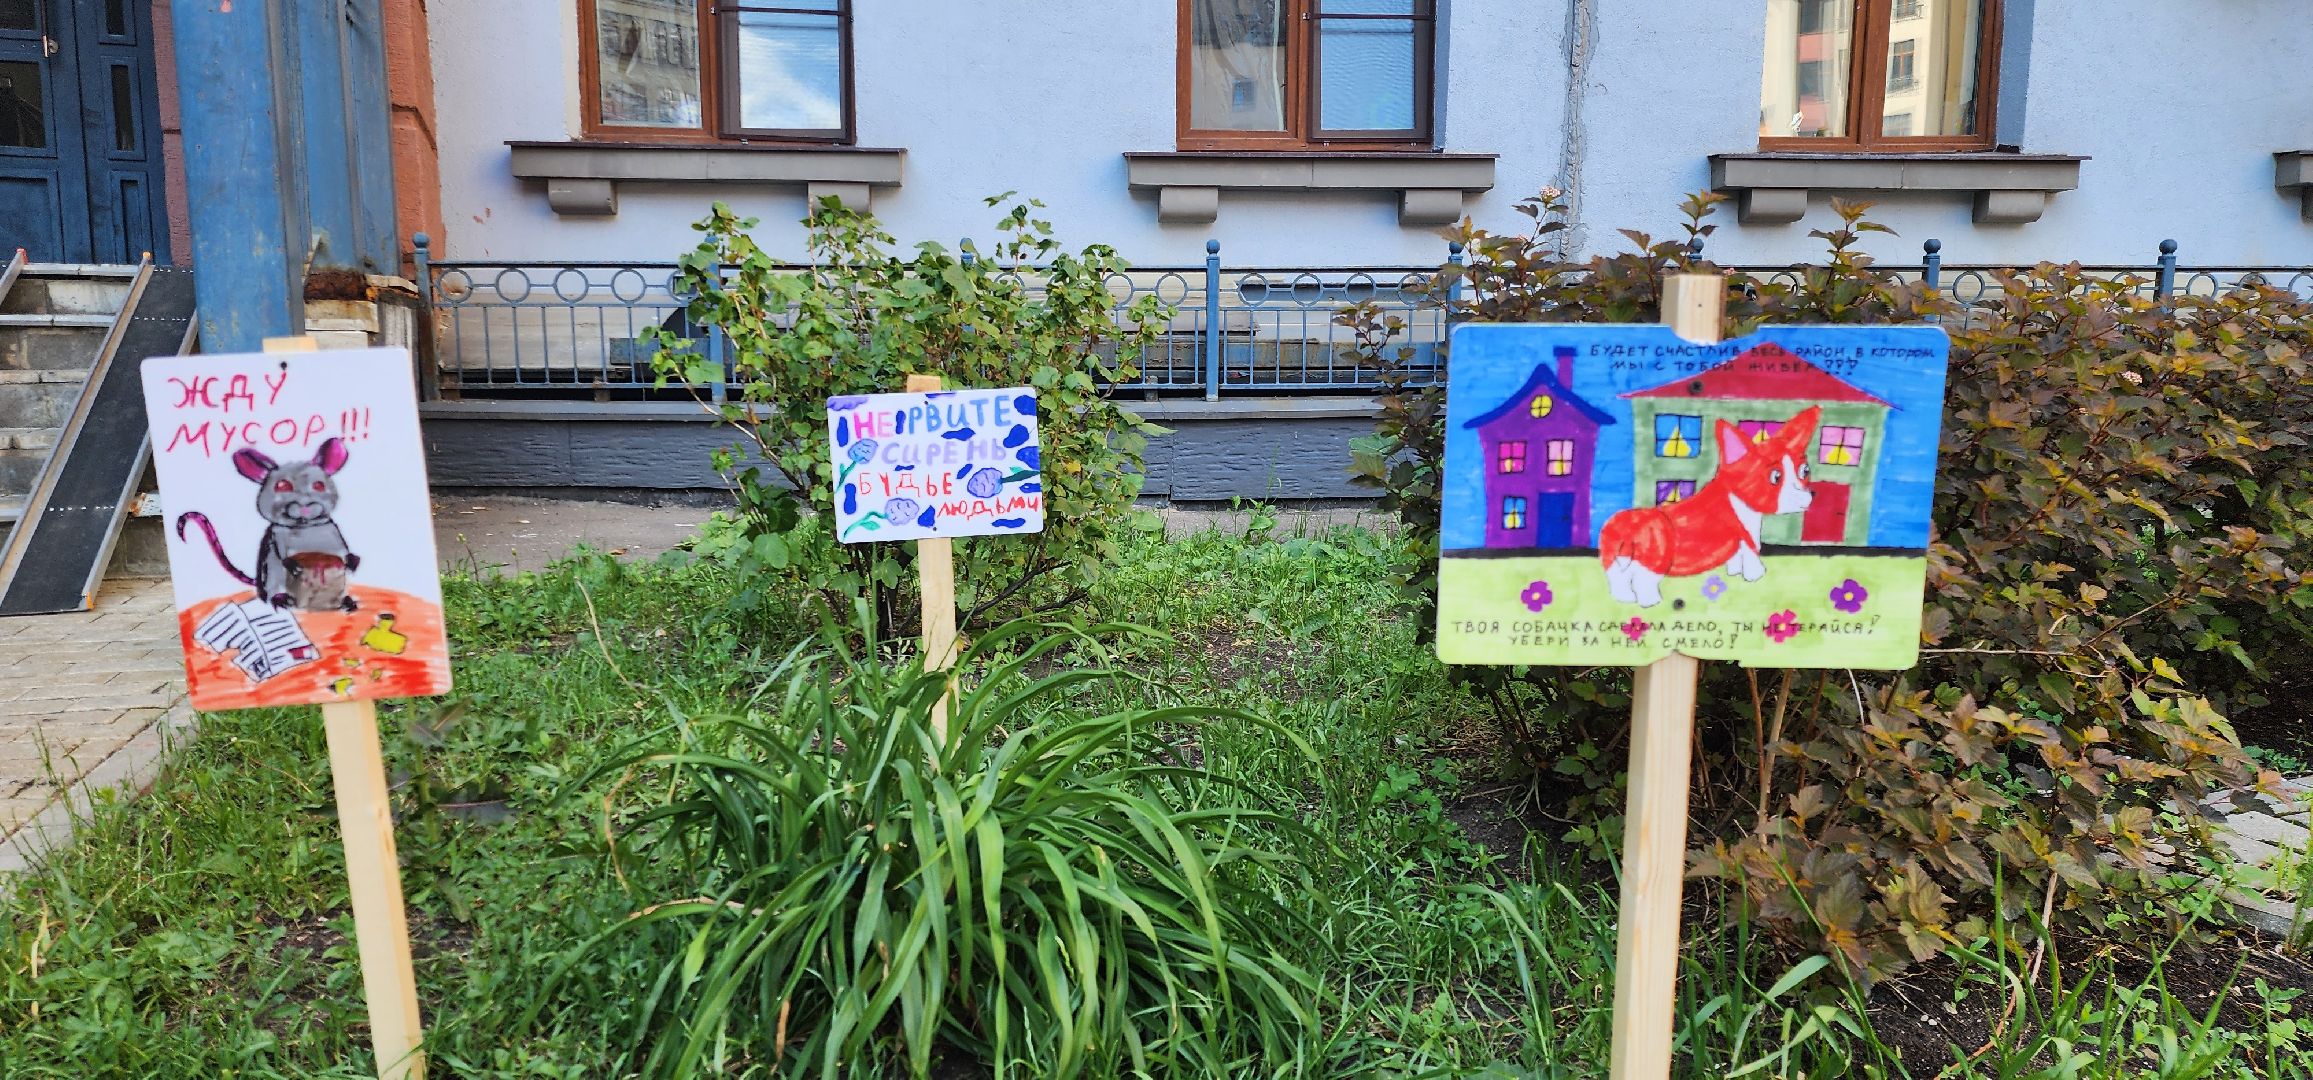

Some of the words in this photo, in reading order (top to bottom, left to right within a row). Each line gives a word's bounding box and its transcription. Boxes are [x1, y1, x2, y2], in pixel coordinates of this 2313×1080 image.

[1590, 344, 1648, 357] БУДЕТ
[1655, 345, 1741, 357] СЧАСТЛИВ
[1751, 346, 1785, 357] ВЕСЬ
[1856, 347, 1863, 358] В
[1871, 347, 1934, 361] КОТОРОМ
[1611, 361, 1643, 371] МЫ
[1654, 360, 1666, 371] С
[1674, 360, 1734, 373] ТОБОЙ
[167, 371, 287, 413] ЖДУ
[853, 410, 894, 439] НЕ
[909, 395, 1012, 435] РВИТЕ
[880, 438, 1007, 466] СИРЕНЬ
[937, 496, 1039, 521] ЛЮДЬМИ
[1451, 621, 1500, 634] ТВОЯ
[1512, 620, 1593, 633] СОБАЧКА
[1672, 621, 1722, 636] ДЕЛО,
[1731, 621, 1753, 633] ТЫ
[1762, 622, 1786, 634] НЕ
[1508, 635, 1569, 647] УБЕРИ
[1582, 636, 1599, 646] ЗА
[1611, 635, 1647, 648] НЕЙ
[1663, 633, 1738, 649] СМЕЛО!
